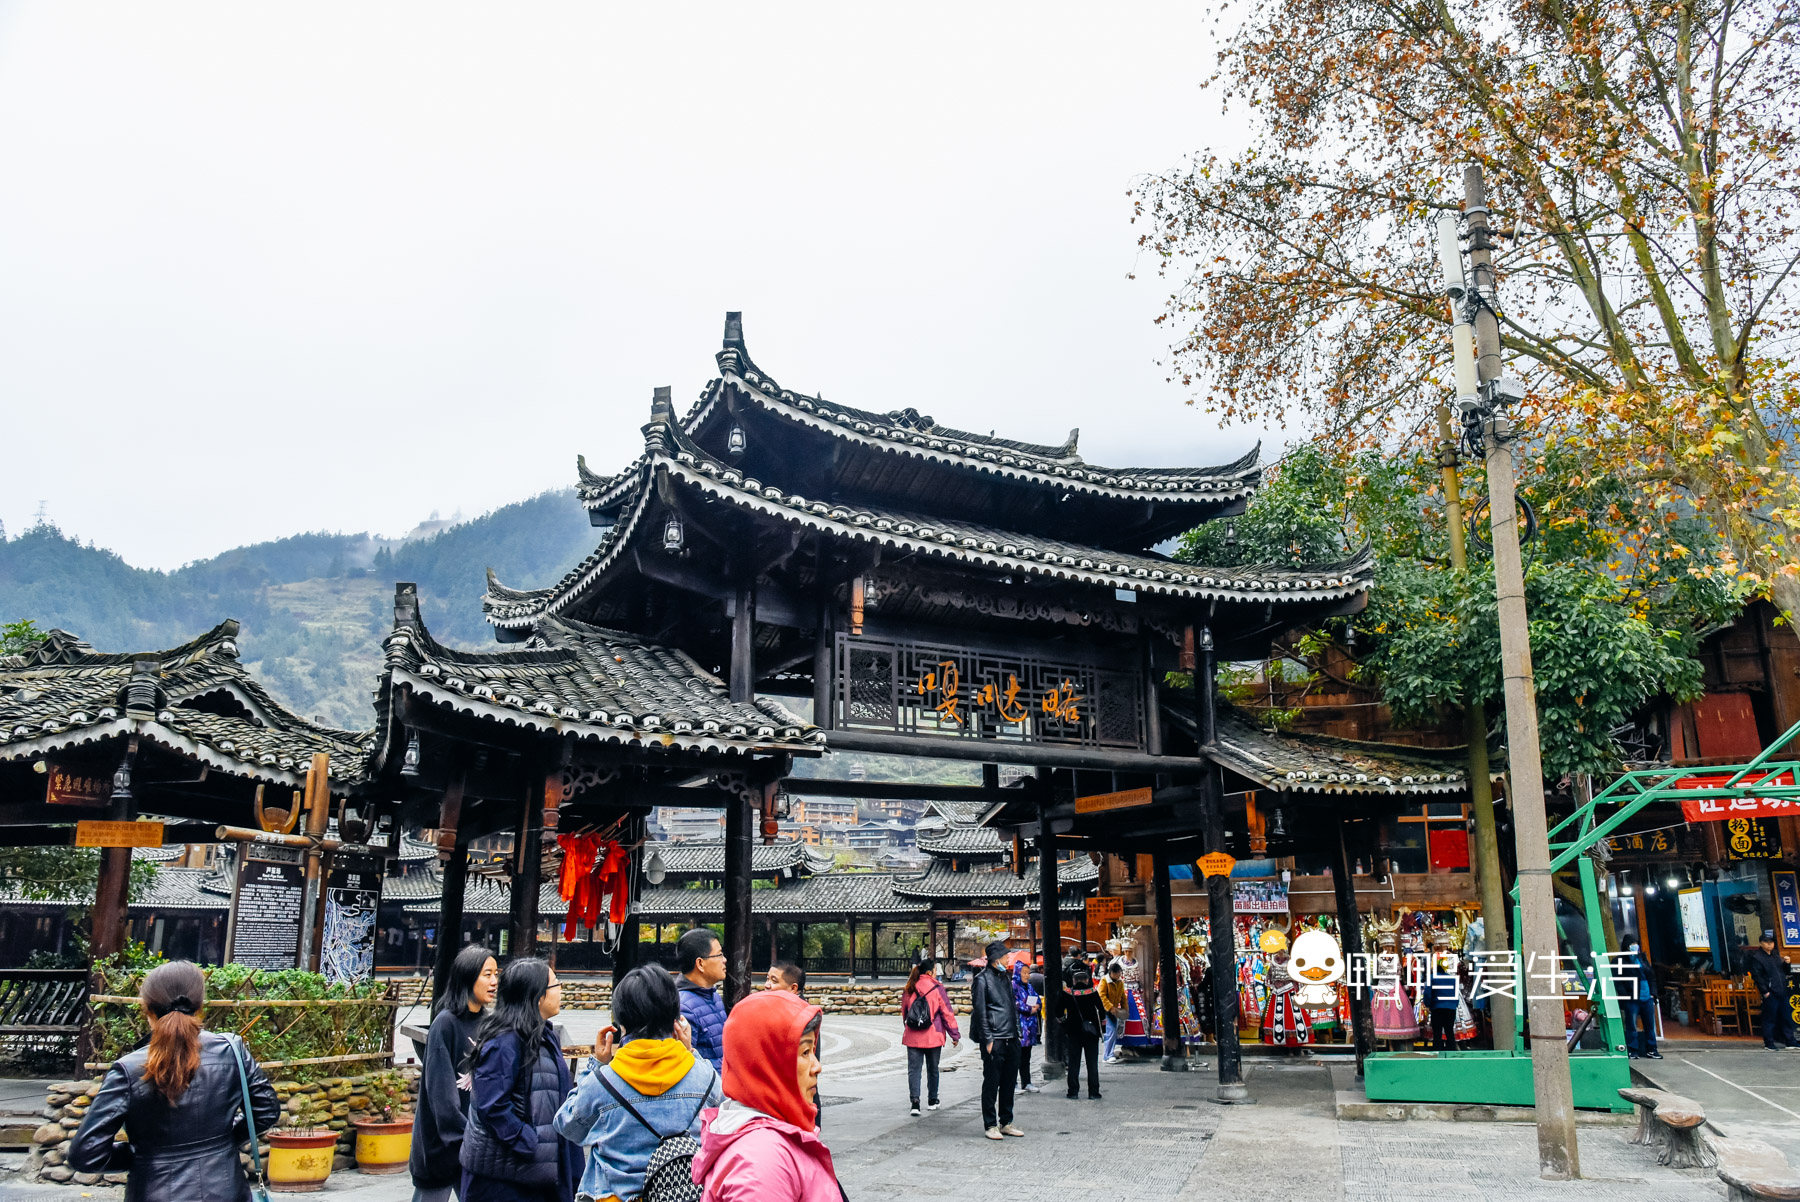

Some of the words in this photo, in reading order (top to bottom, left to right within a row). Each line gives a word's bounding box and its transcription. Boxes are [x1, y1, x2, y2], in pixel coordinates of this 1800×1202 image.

[1696, 777, 1800, 814] 让运动
[1235, 900, 1287, 910] 苗服出租拍照
[1779, 879, 1799, 939] 今日有房
